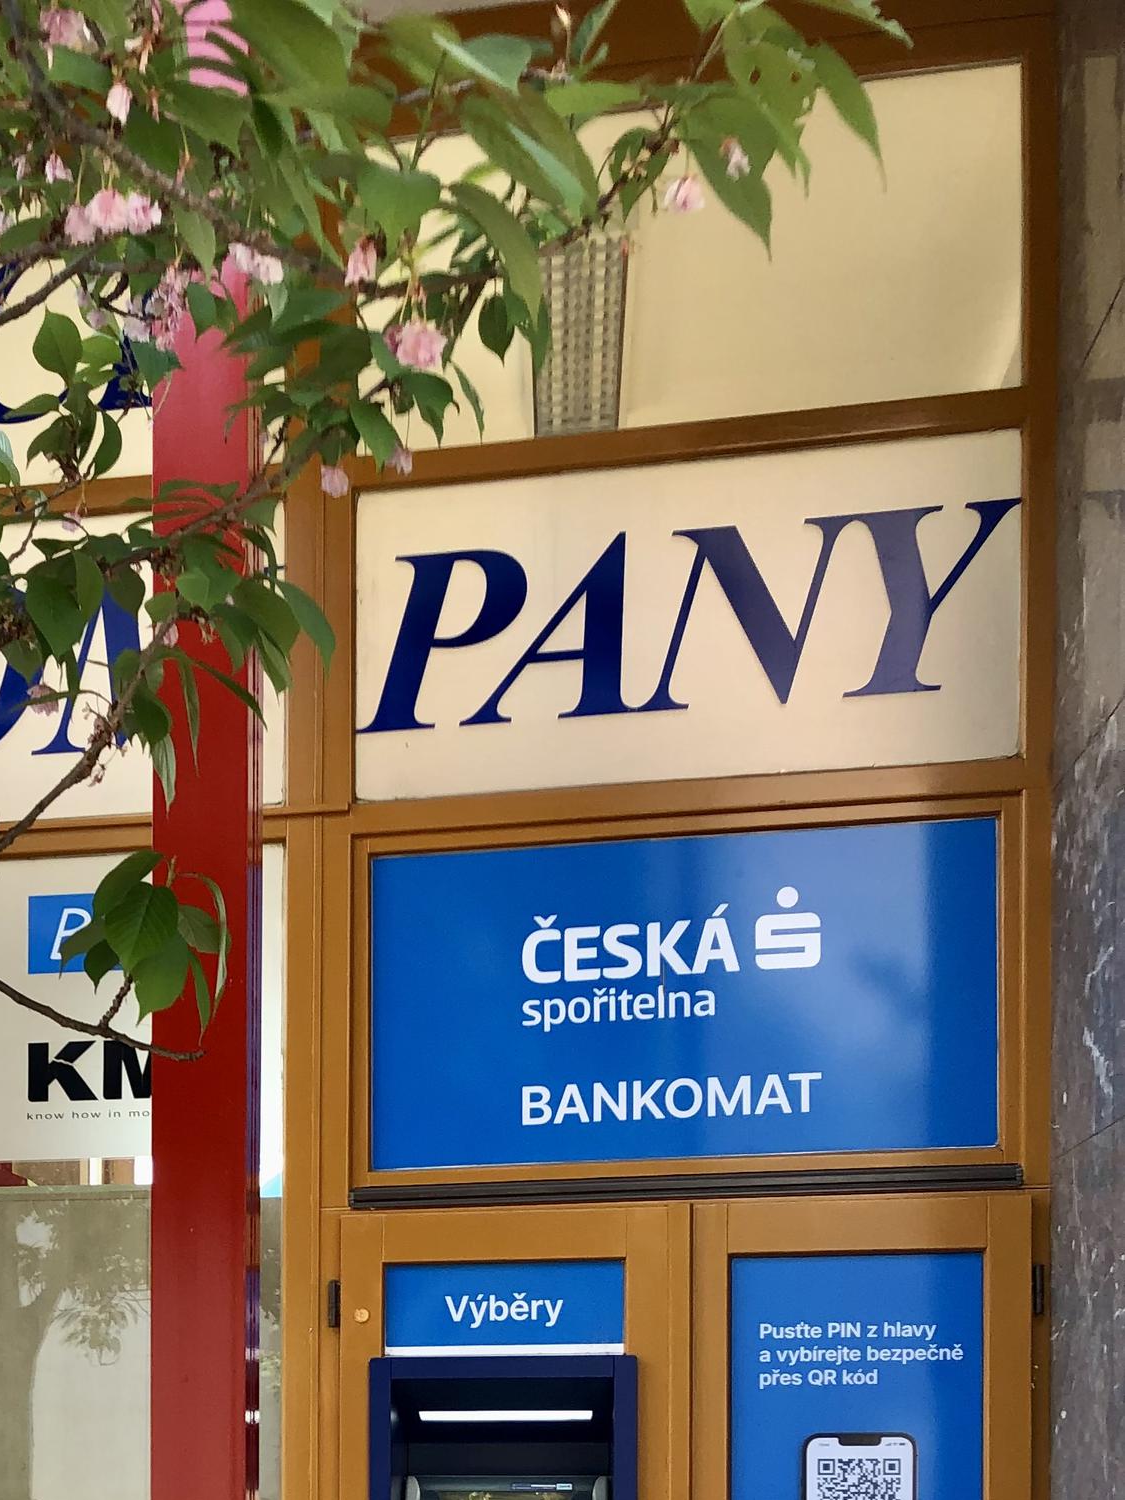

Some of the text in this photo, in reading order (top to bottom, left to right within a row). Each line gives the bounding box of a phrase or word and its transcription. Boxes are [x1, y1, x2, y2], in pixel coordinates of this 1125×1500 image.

[355, 497, 1022, 733] PANY
[522, 904, 739, 983] ČESKÁ
[522, 984, 716, 1032] spořitelna
[27, 1111, 64, 1120] know
[72, 1110, 101, 1119] how
[109, 1108, 120, 1118] in
[521, 1072, 822, 1125] BANKOMAT
[445, 1293, 563, 1329] Výběry
[759, 1322, 937, 1340] Pusťte PIN z hlavy
[759, 1343, 964, 1366] a vybírejte bezpečně
[759, 1369, 879, 1389] přes QR kód
